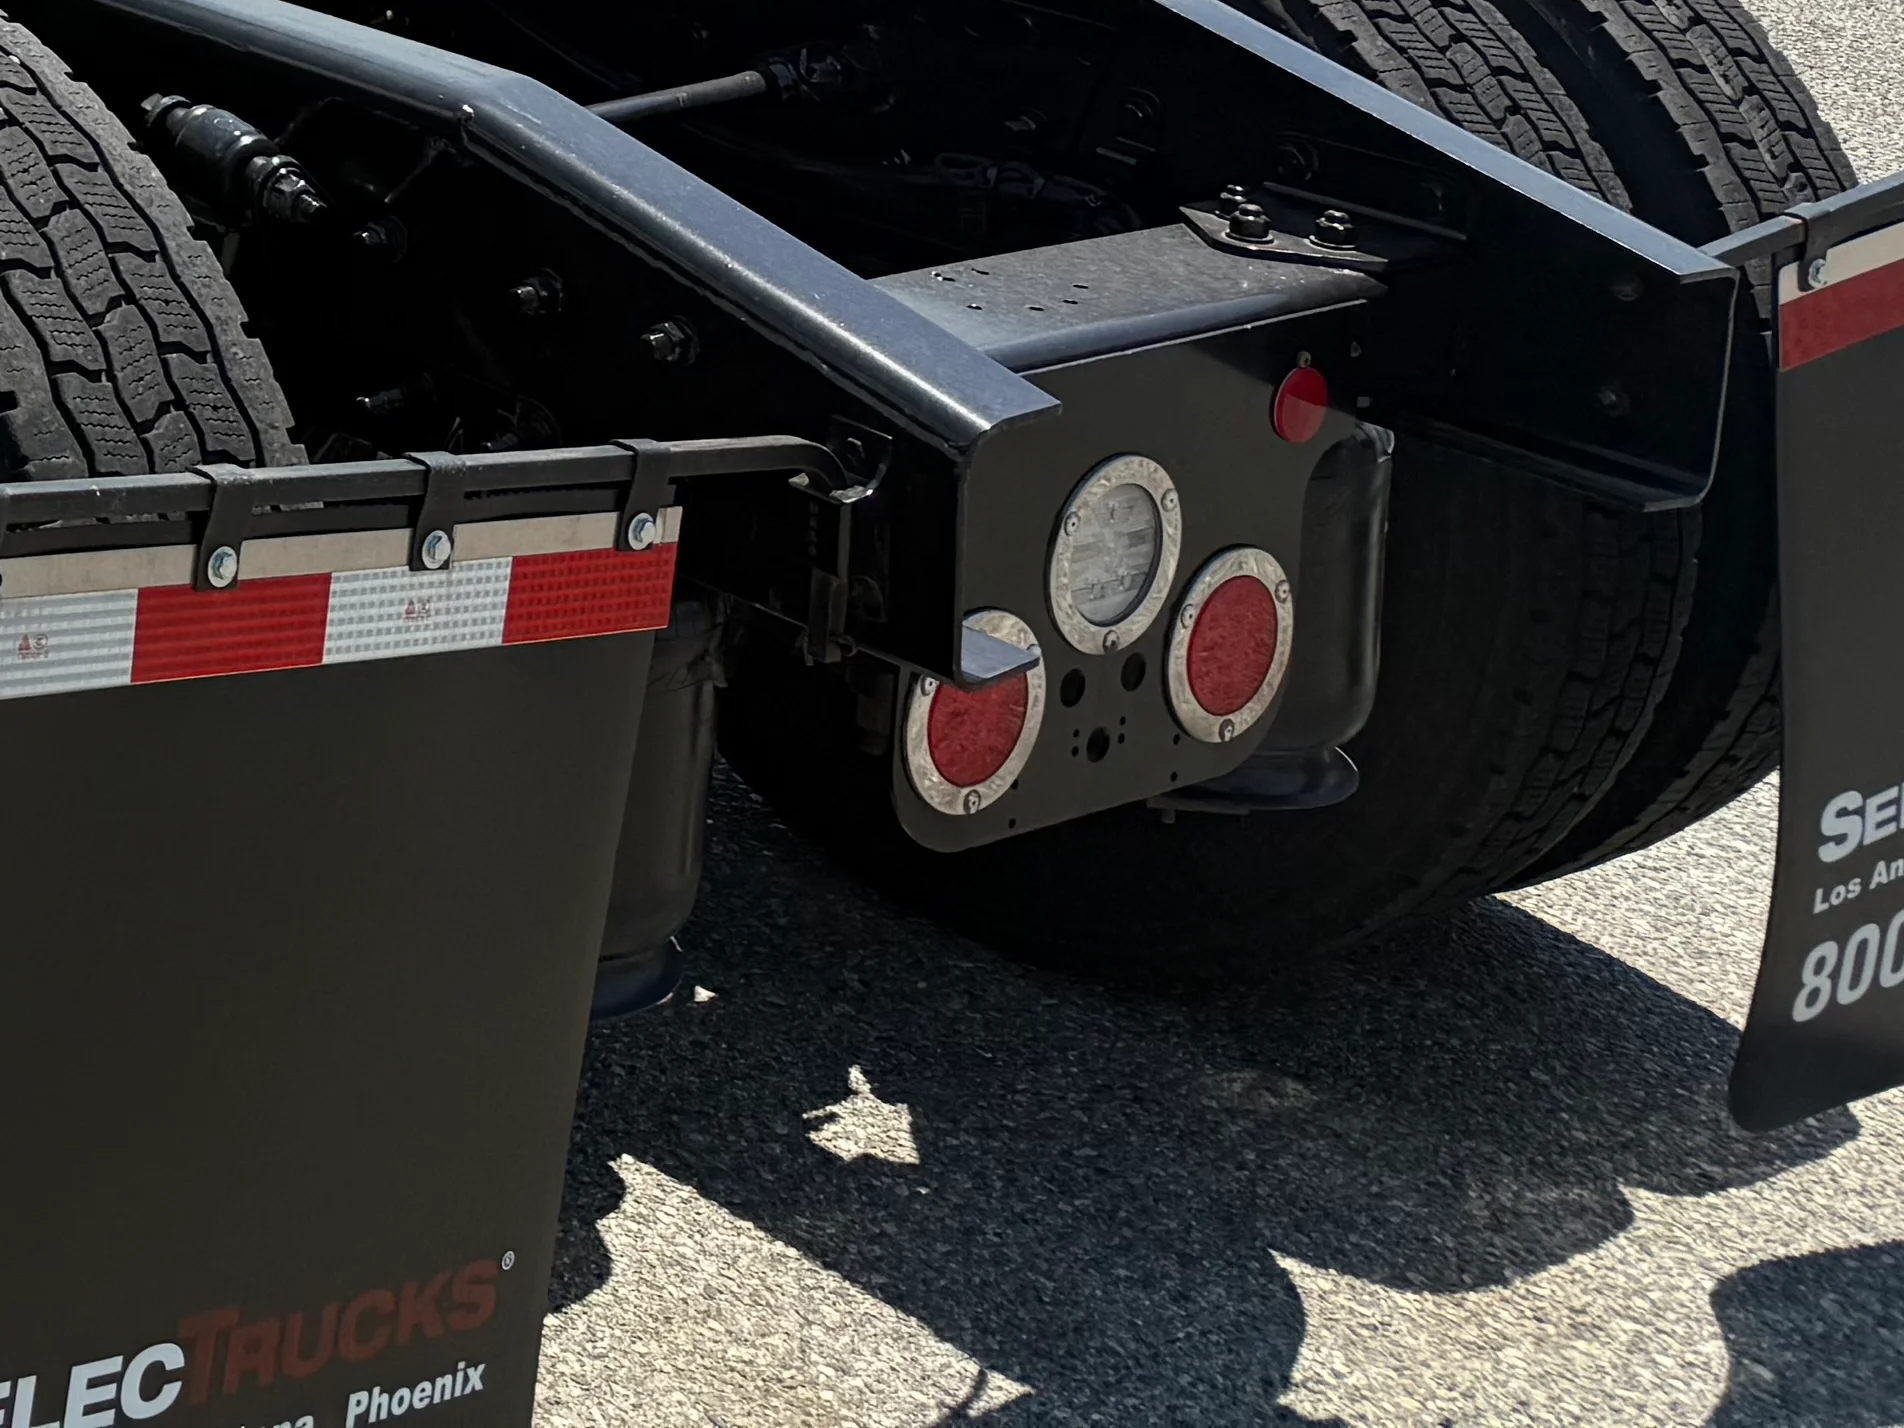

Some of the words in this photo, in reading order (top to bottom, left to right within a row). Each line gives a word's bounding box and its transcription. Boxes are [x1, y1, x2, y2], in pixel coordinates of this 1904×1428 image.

[1817, 783, 1904, 863] SE
[1813, 877, 1861, 914] Los
[1792, 908, 1904, 1023] 800
[346, 1361, 486, 1428] Phoenix
